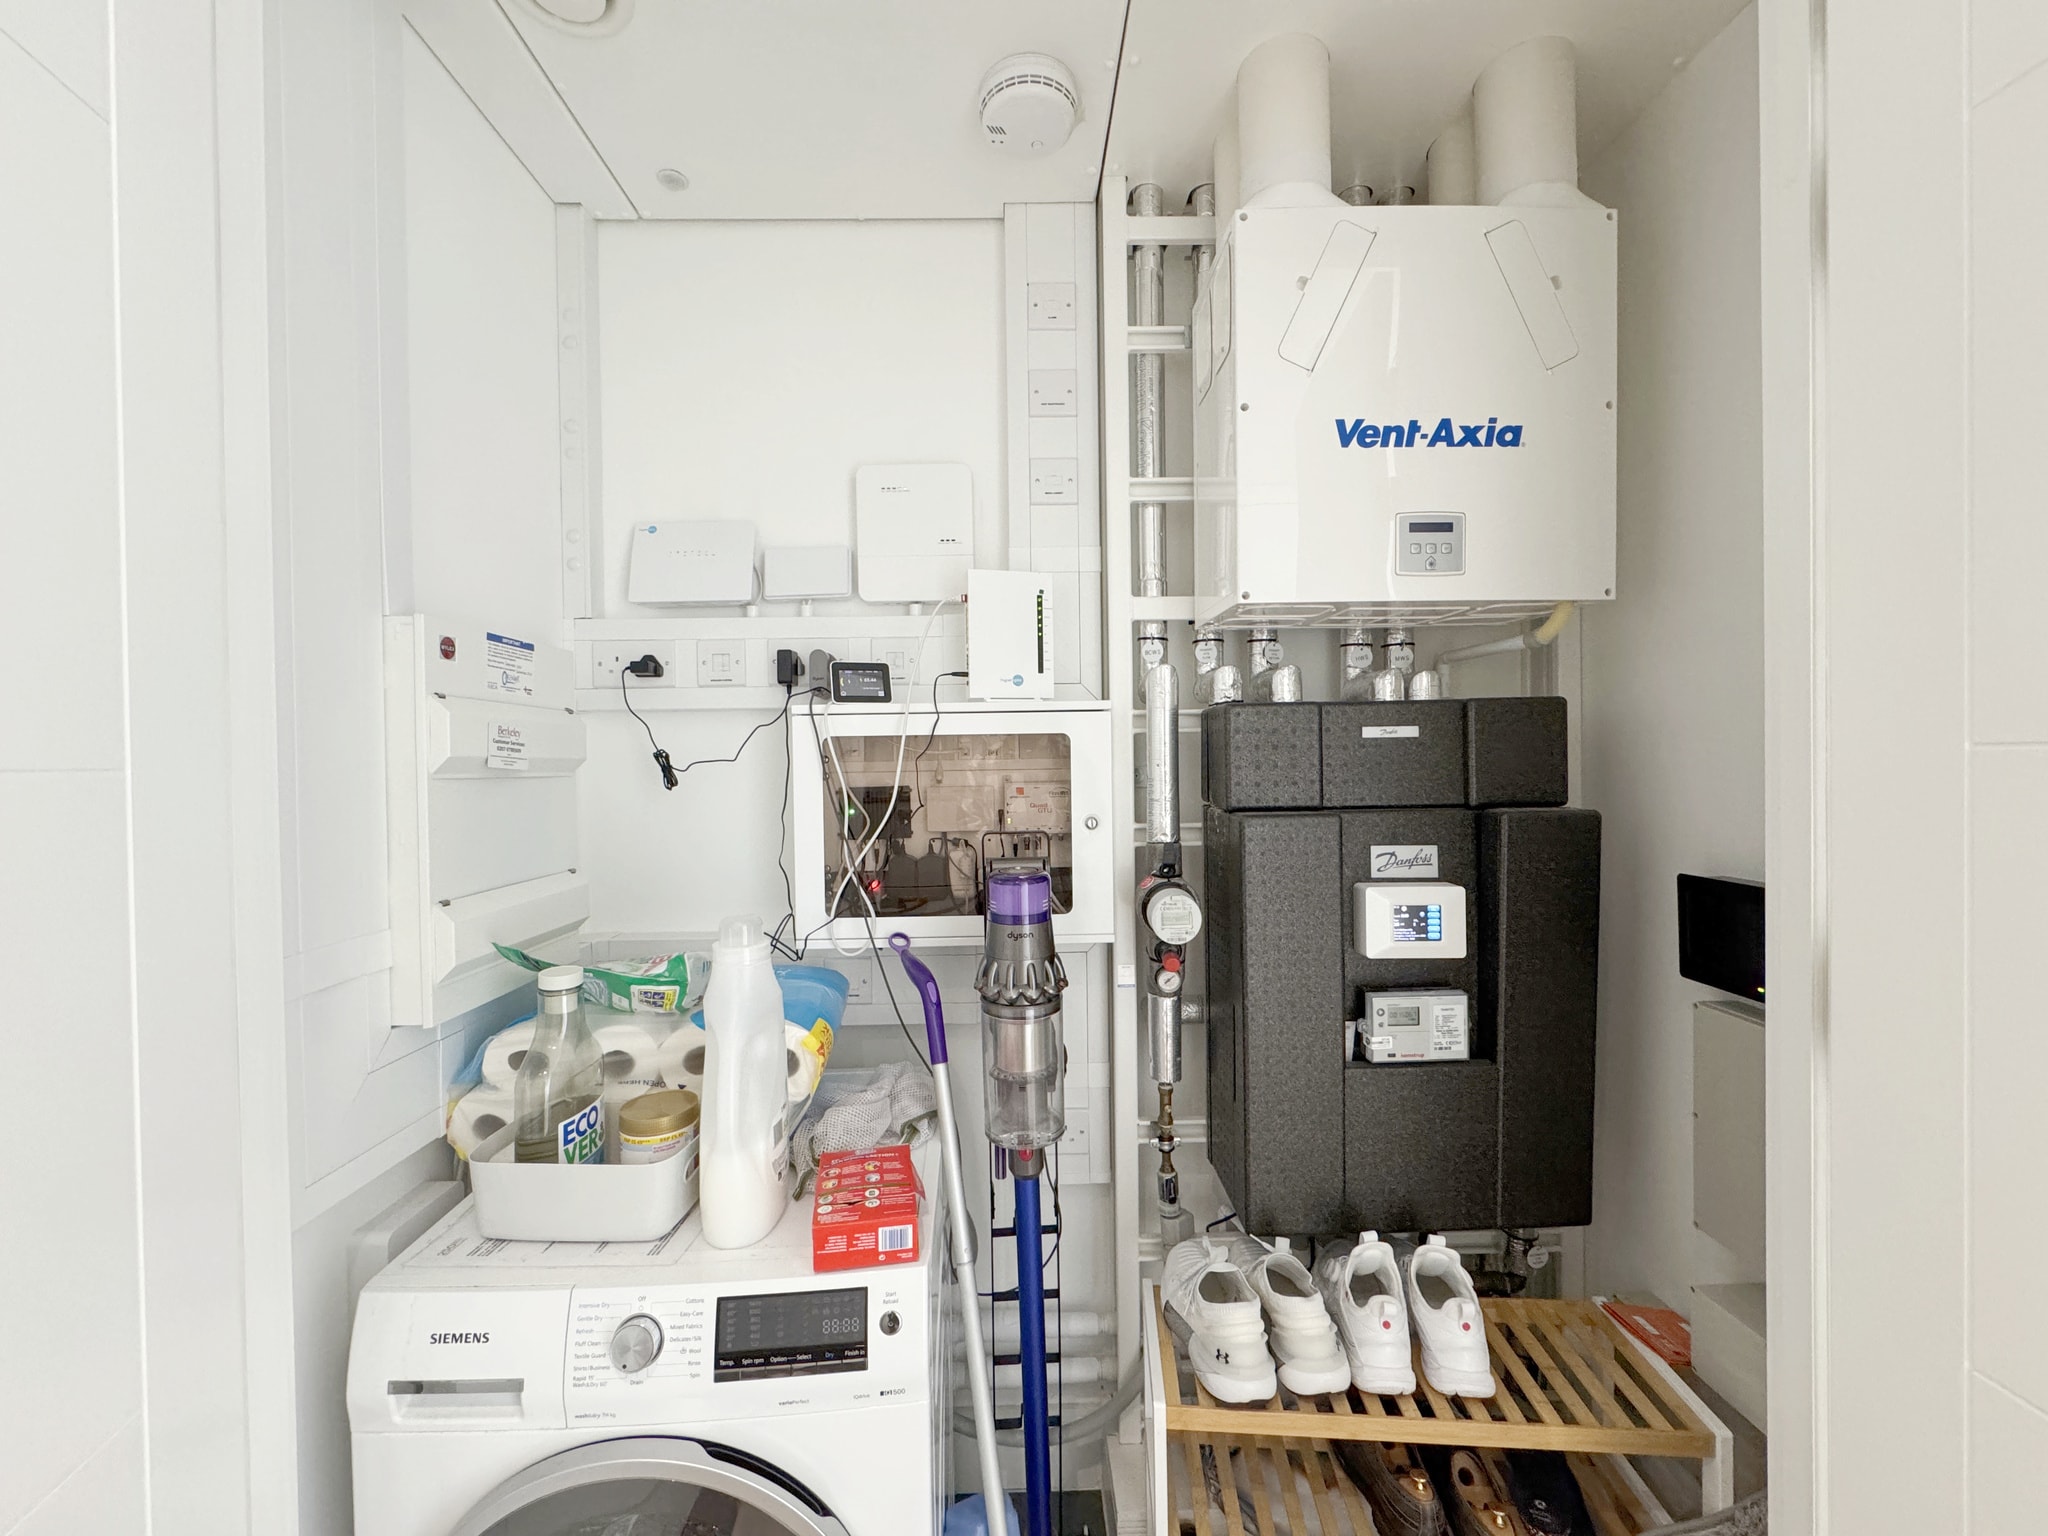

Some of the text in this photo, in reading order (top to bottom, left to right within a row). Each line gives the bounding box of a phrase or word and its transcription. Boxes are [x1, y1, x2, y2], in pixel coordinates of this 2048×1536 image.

[1335, 417, 1523, 448] Vent-Axia
[1375, 848, 1433, 872] Danfoss
[1007, 931, 1034, 941] dyson
[643, 1080, 667, 1088] OPEN
[563, 1105, 598, 1147] ECO
[430, 1332, 490, 1345] SIEMENS
